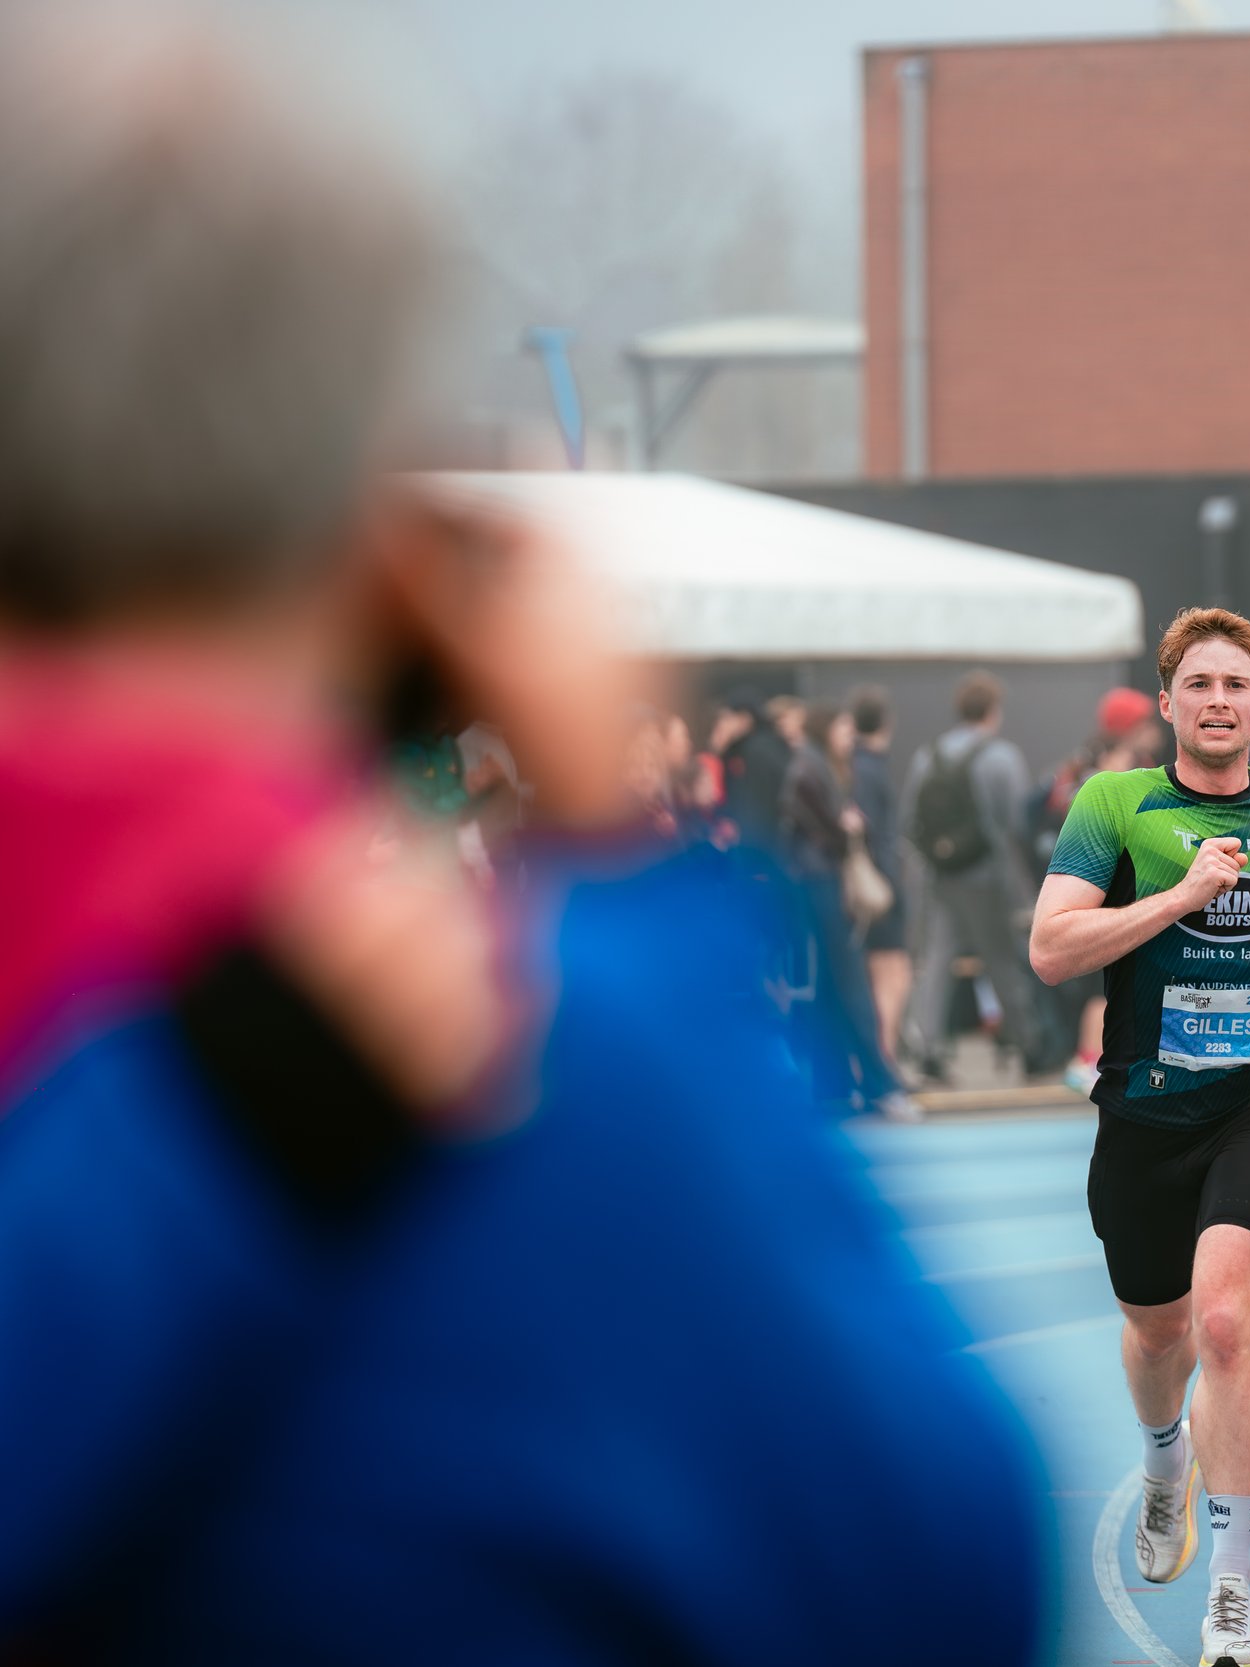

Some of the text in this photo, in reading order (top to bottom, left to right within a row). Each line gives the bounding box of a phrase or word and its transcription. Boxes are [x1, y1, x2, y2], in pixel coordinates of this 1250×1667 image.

[1183, 946, 1216, 959] Built
[1219, 948, 1235, 959] to
[1205, 1042, 1232, 1053] 2283
